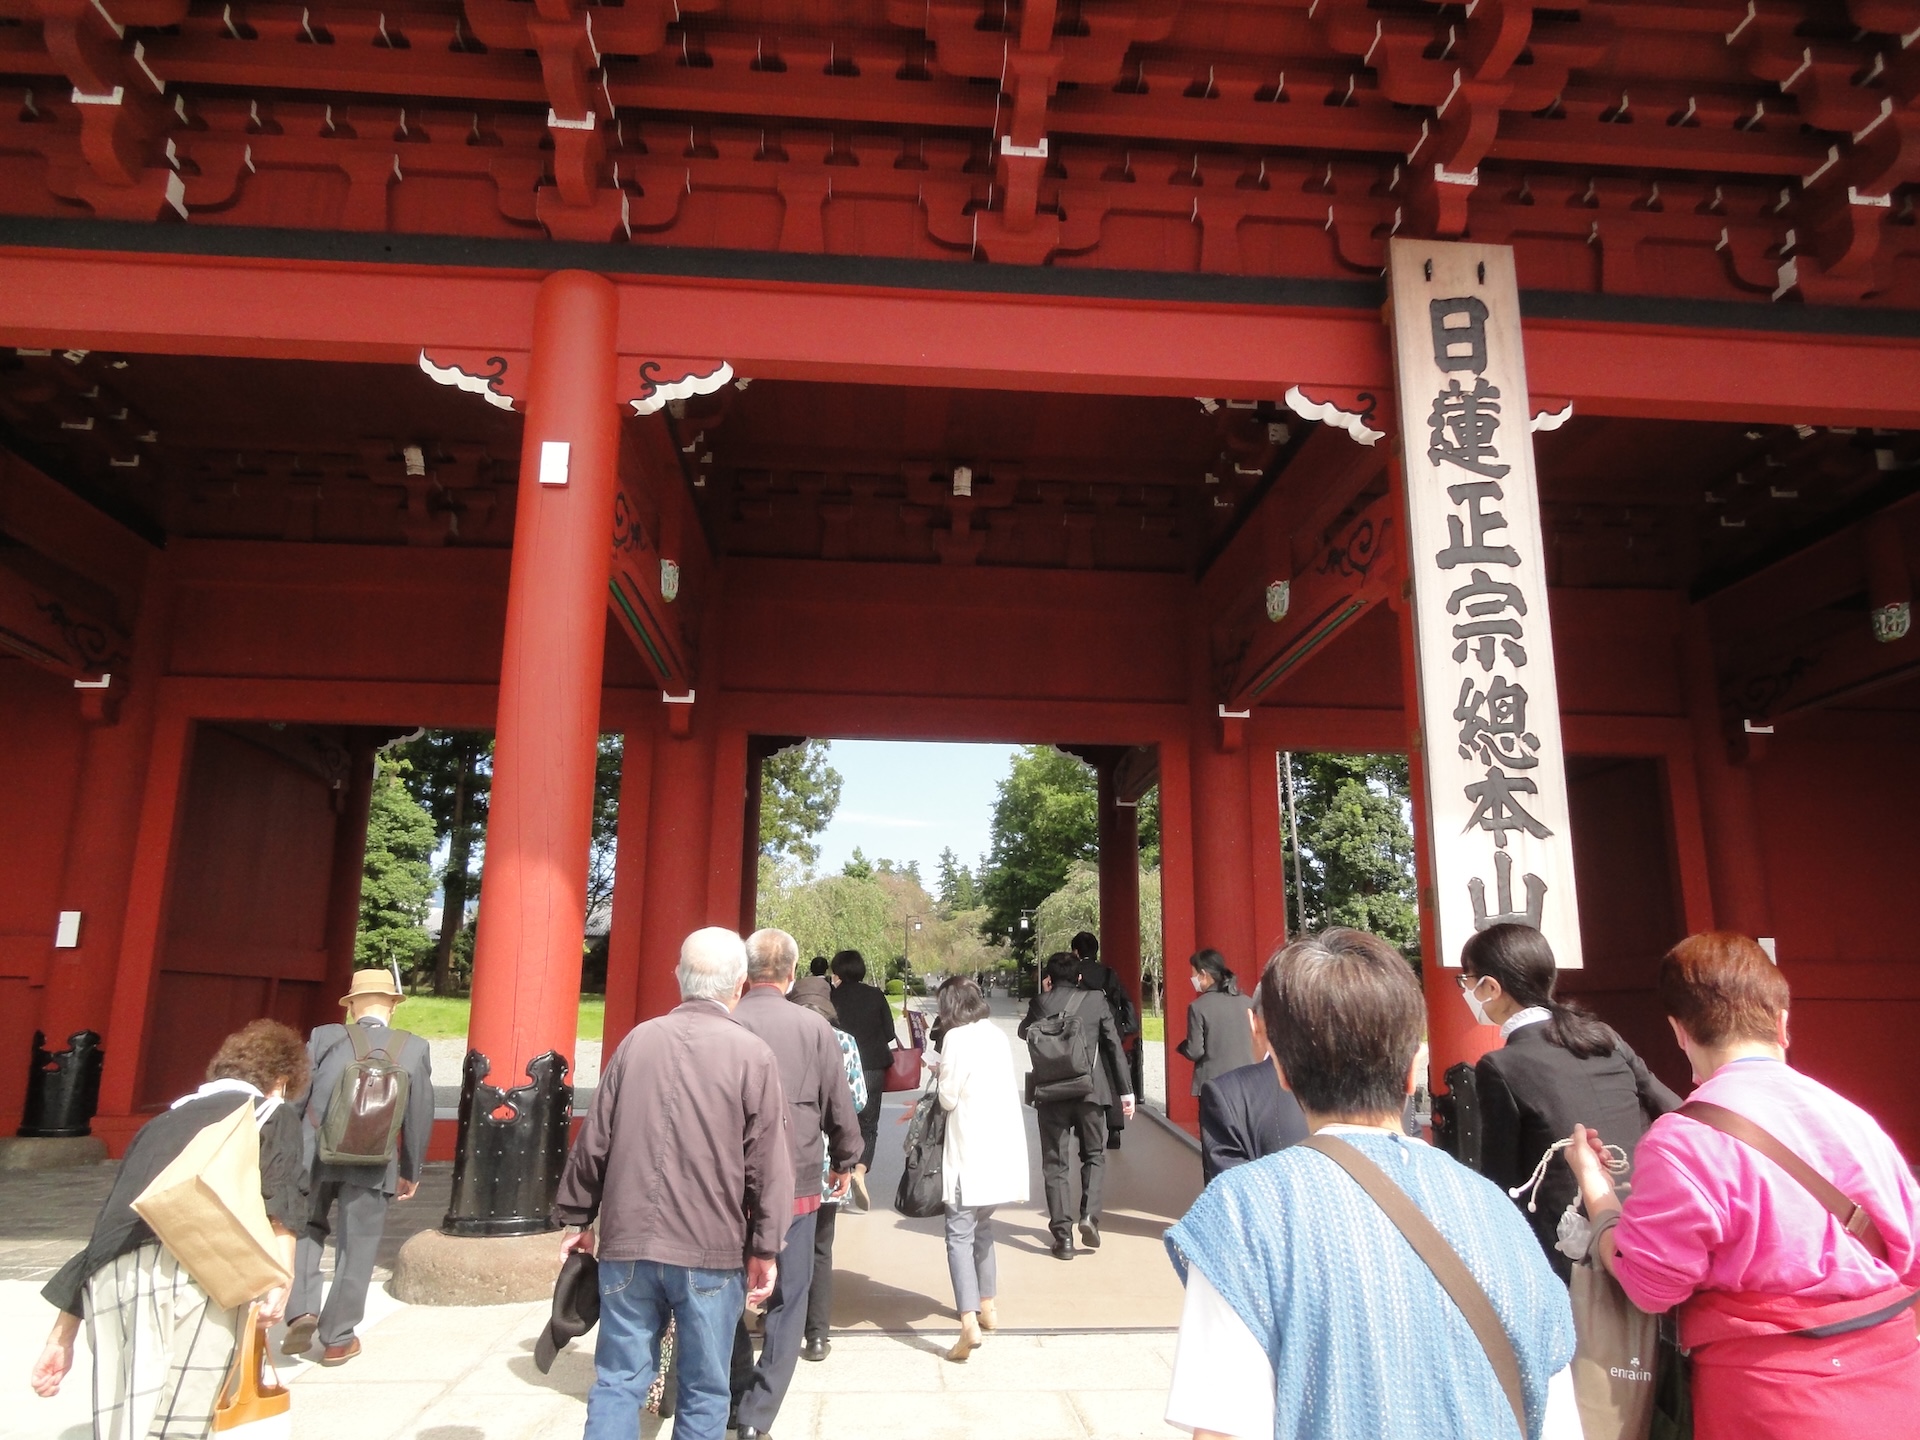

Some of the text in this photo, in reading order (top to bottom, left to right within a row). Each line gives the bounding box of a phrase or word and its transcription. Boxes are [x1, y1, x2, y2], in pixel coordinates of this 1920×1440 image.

[1427, 296, 1554, 932] 日蓮正宗總本山
